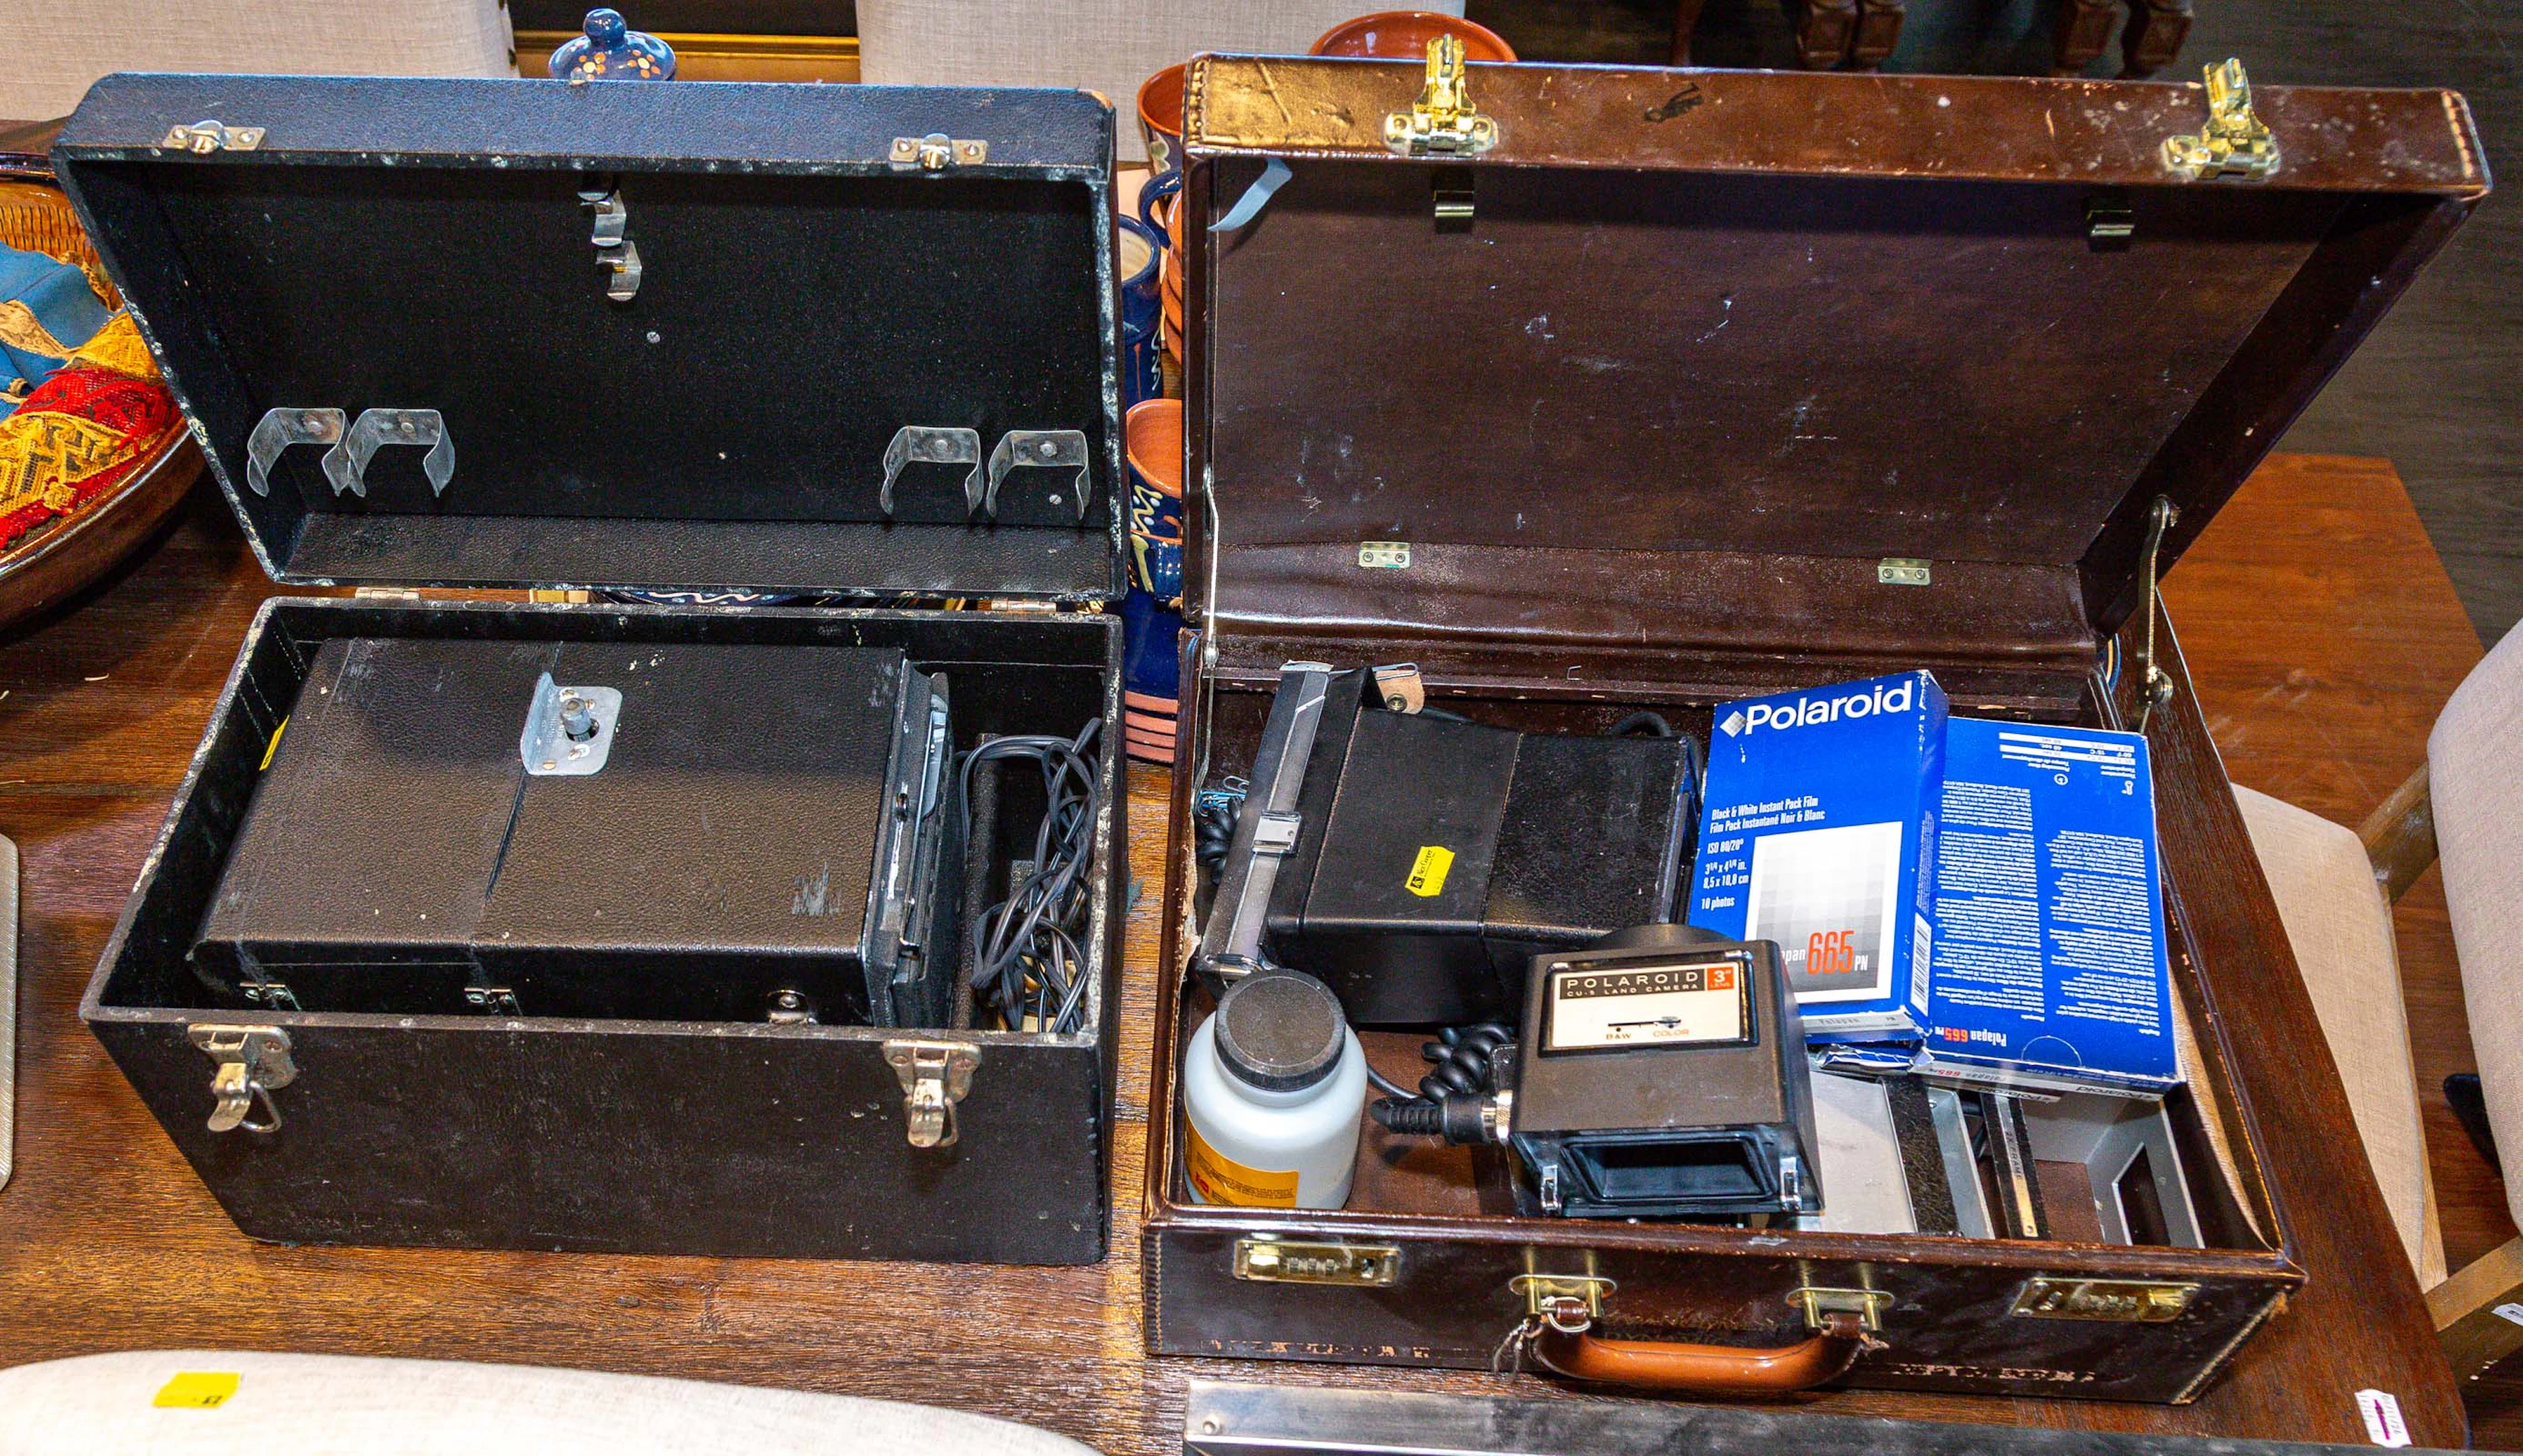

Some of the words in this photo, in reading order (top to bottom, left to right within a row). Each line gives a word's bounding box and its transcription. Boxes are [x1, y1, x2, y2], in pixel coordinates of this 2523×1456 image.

[1744, 680, 1913, 735] Polaroid
[1712, 808, 1730, 821] Black
[1731, 808, 1737, 818] &
[1738, 804, 1758, 817] White
[1760, 801, 1783, 813] Instant
[1784, 798, 1802, 811] Pack
[1803, 796, 1819, 808] Film
[1710, 823, 1724, 834] Film
[1725, 820, 1741, 832] Pack
[1742, 814, 1779, 830] Instantané
[1781, 812, 1795, 824] Noir
[1797, 812, 1803, 822] &
[1805, 810, 1825, 821] Blanc
[1708, 841, 1719, 854] ISO
[1718, 862, 1723, 873] x
[1738, 859, 1746, 871] in.
[1716, 877, 1720, 886] x
[1738, 874, 1749, 884] cm
[1702, 898, 1710, 910] 10
[1711, 896, 1735, 911] photos
[1781, 949, 1806, 965] pan
[1807, 930, 1855, 975] 665
[1855, 955, 1868, 972] PN
[1567, 972, 1698, 989] POLAROID
[1646, 984, 1698, 992] CAMERA
[1653, 1029, 1689, 1037] COLOR
[1944, 1027, 1969, 1042] 665
[1971, 1032, 2007, 1046] Polapan
[2077, 1085, 2145, 1099] Polaroid
